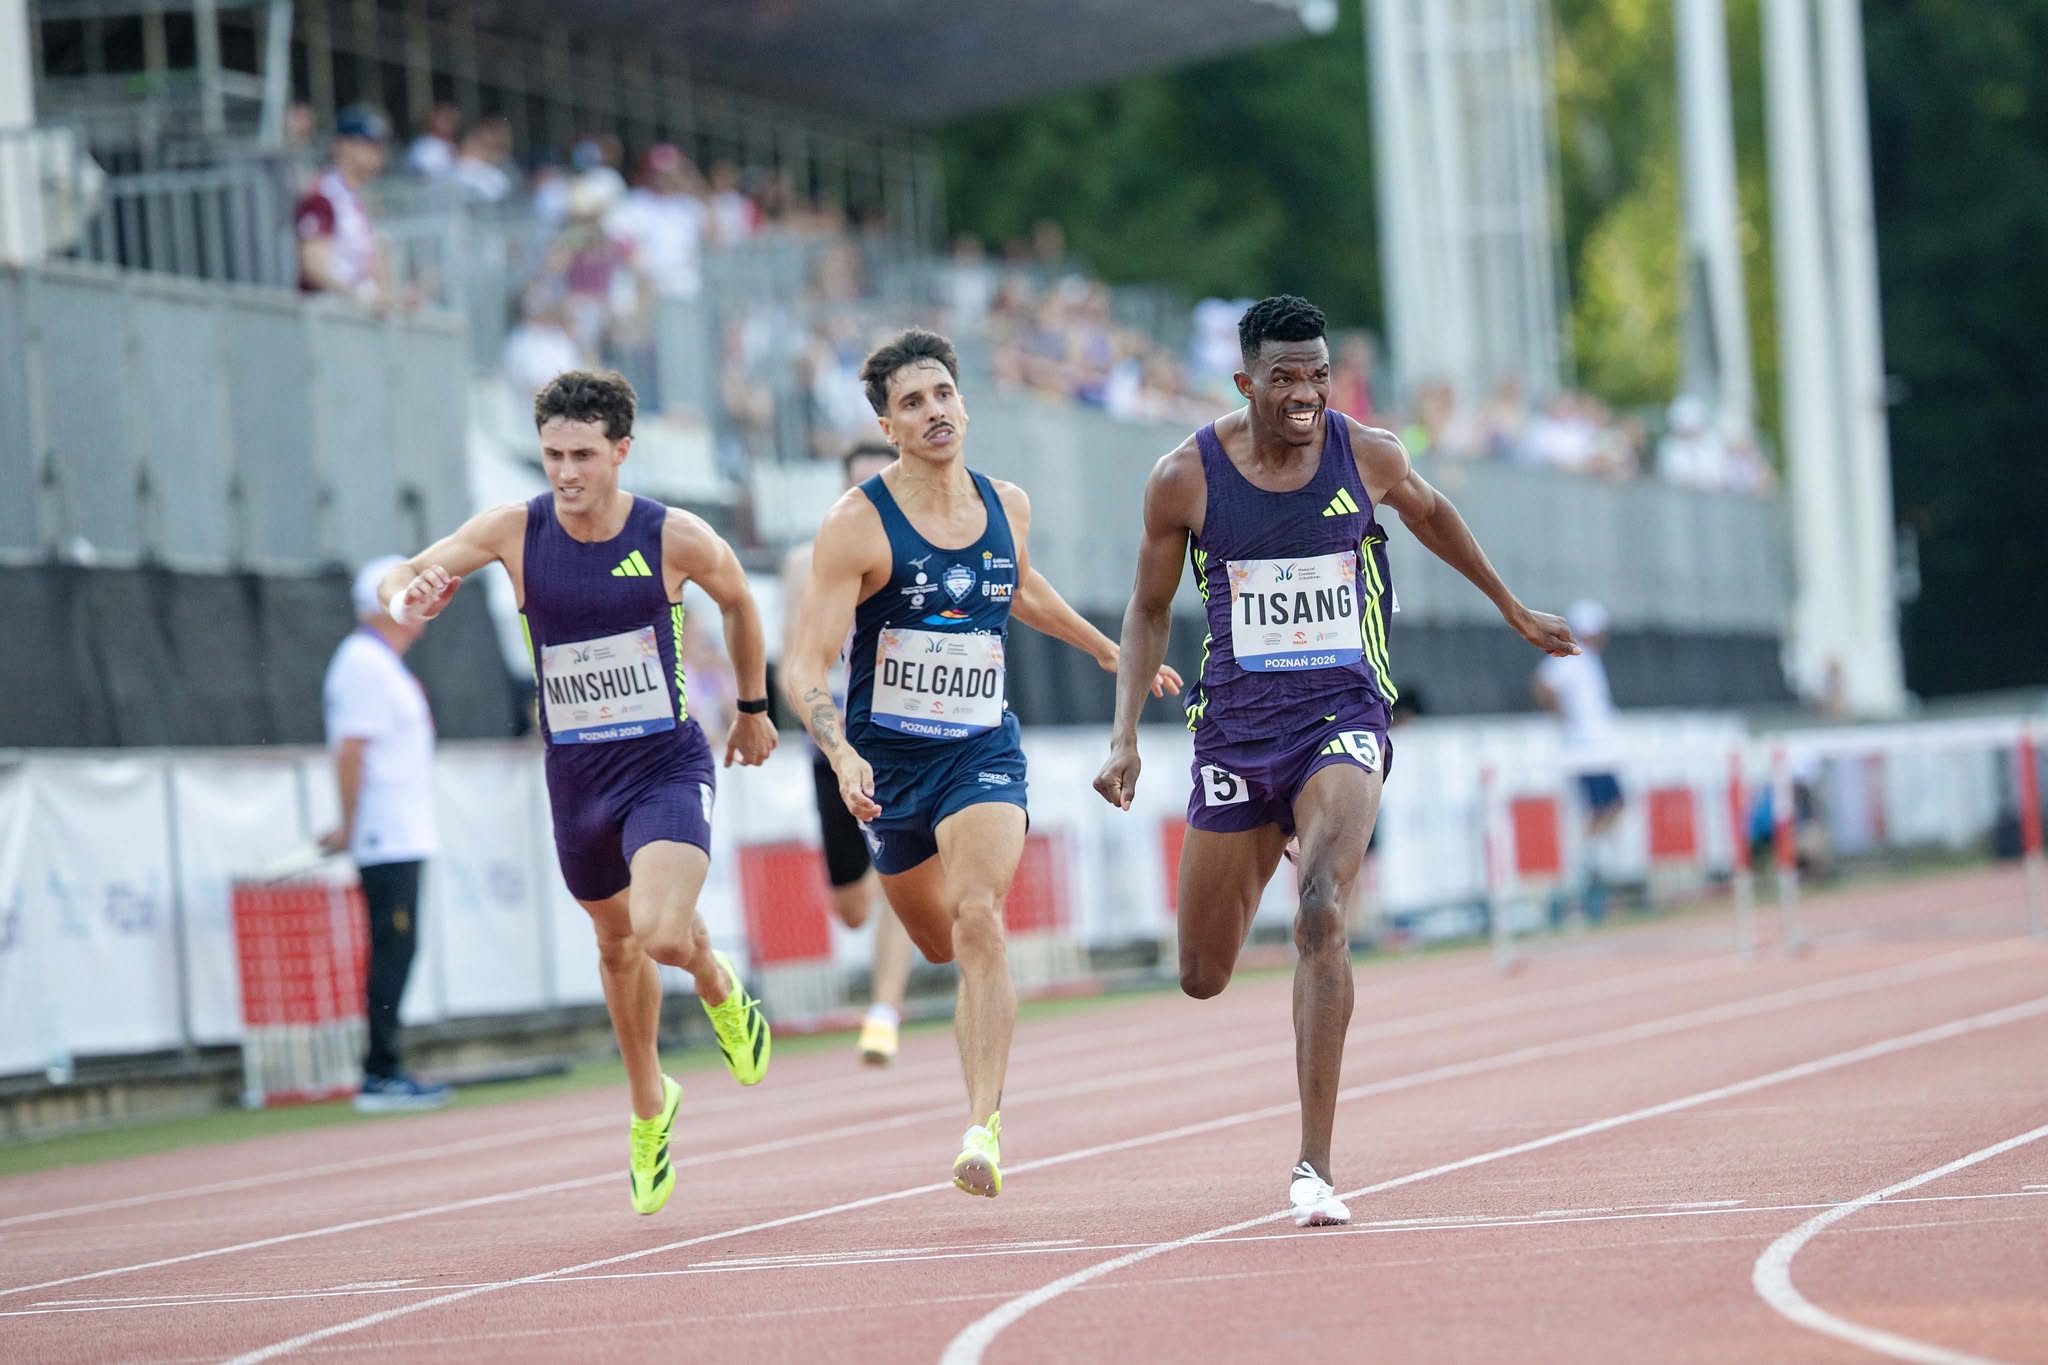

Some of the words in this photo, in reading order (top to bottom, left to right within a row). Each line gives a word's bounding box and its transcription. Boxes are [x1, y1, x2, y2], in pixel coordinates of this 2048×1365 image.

[990, 583, 1013, 596] DXT
[1239, 585, 1352, 626] TISANG
[1265, 655, 1308, 668] POZNAŃ
[1310, 655, 1336, 666] 2026
[546, 662, 658, 705] MINSHULL
[883, 658, 997, 698] DELGADO
[900, 721, 942, 736] POZNAŃ
[943, 728, 969, 738] 2026
[1352, 734, 1376, 765] 5
[1212, 769, 1238, 801] 5
